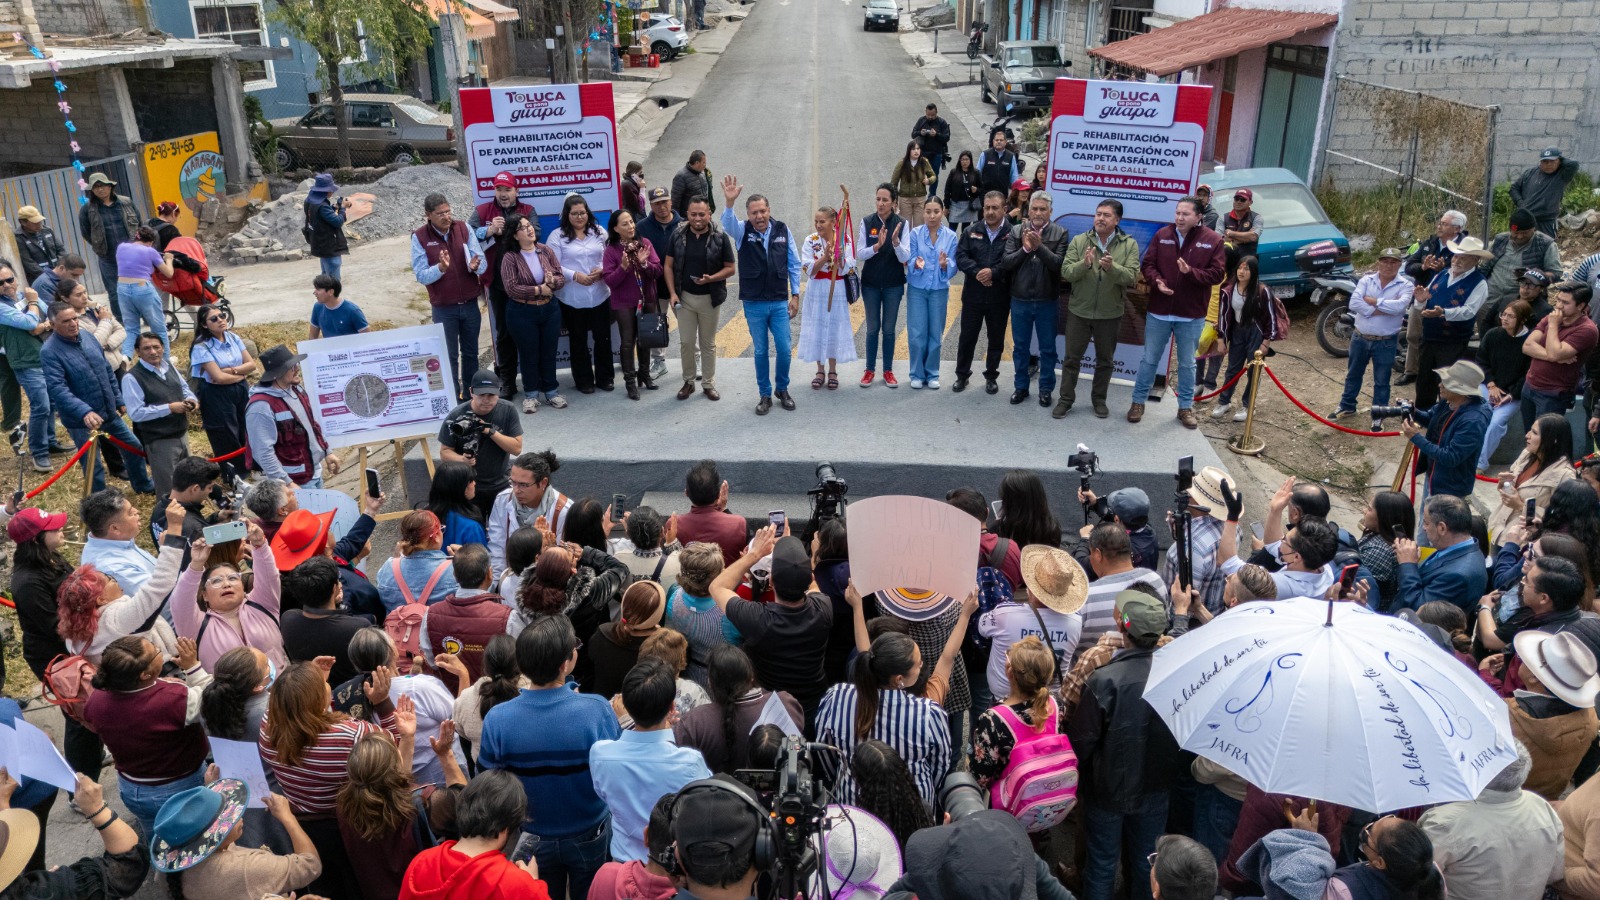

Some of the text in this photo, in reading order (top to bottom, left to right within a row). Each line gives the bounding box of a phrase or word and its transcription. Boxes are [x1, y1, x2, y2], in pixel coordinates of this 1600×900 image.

[505, 91, 566, 104] TOLUCA
[1100, 88, 1161, 102] TOLUCA
[510, 105, 566, 123] guapa
[1099, 106, 1159, 120] guapa
[498, 130, 582, 144] REHABILITACIÓN
[1083, 130, 1170, 144] REHABILITACIÓN
[479, 142, 603, 156] DE PAVIMENTACIÓN CON
[1061, 141, 1189, 158] DE PAVIMENTACIÓN CON
[492, 152, 593, 166] CARPETA ASFÁLTICA
[1072, 152, 1175, 167] CARPETA ASFÁLTICA
[543, 163, 570, 171] CALLE
[1120, 166, 1147, 174] CALLE
[529, 176, 549, 185] SAN
[549, 174, 574, 183] JUAN
[575, 172, 608, 181] TILAPA
[1055, 173, 1094, 183] CAMINO
[1104, 177, 1123, 185] SAN
[1125, 178, 1151, 187] JUAN
[1151, 181, 1186, 191] TILAPA
[1172, 698, 1183, 716] la
[1182, 661, 1223, 705] libertad
[1223, 655, 1234, 668] de
[1236, 646, 1254, 661] ser
[1376, 680, 1394, 701] ser
[1380, 701, 1400, 715] de
[1384, 715, 1426, 773] libertad
[1210, 737, 1249, 766] JAFRA
[1470, 747, 1496, 775] JAFRA
[1409, 775, 1430, 793] la
